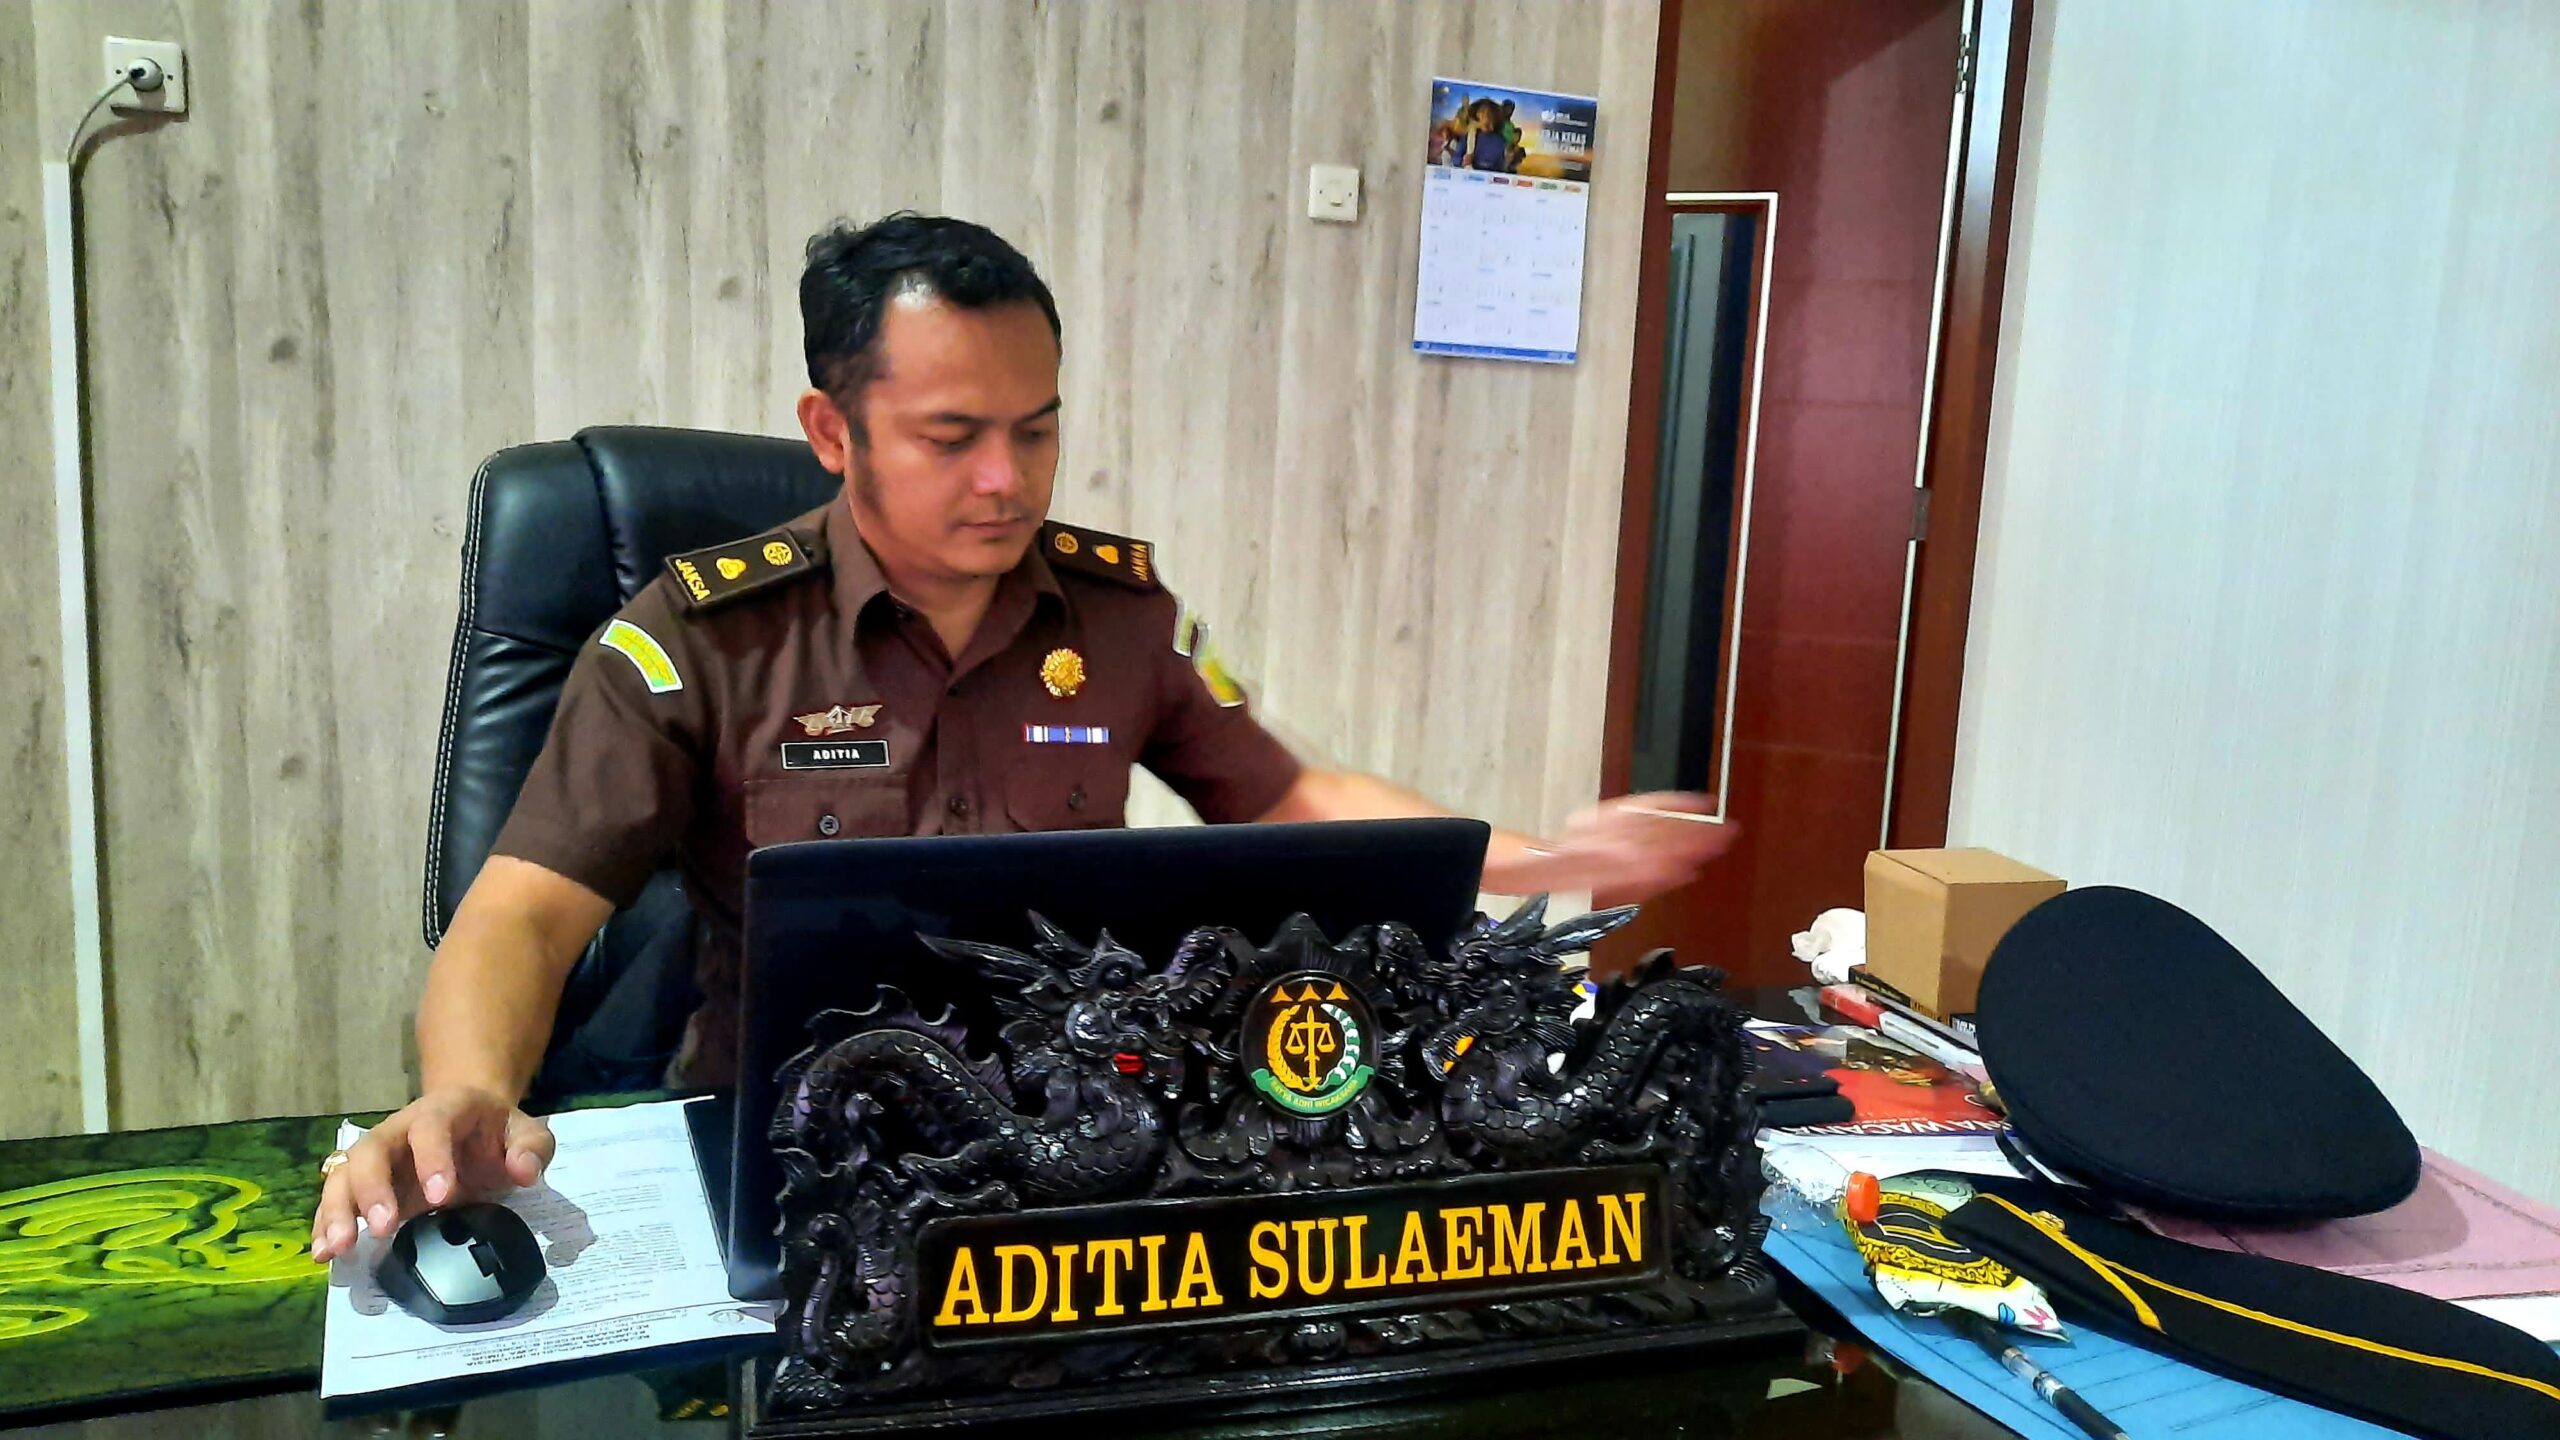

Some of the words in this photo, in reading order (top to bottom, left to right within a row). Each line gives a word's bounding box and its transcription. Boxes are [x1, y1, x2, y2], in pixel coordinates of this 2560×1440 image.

[675, 558, 711, 601] JAKSA
[813, 748, 860, 760] ADITIA
[1781, 1121, 1955, 1135] WACANA
[932, 1231, 1224, 1327] ADITIA
[1248, 1192, 1647, 1300] SULAEMAN
